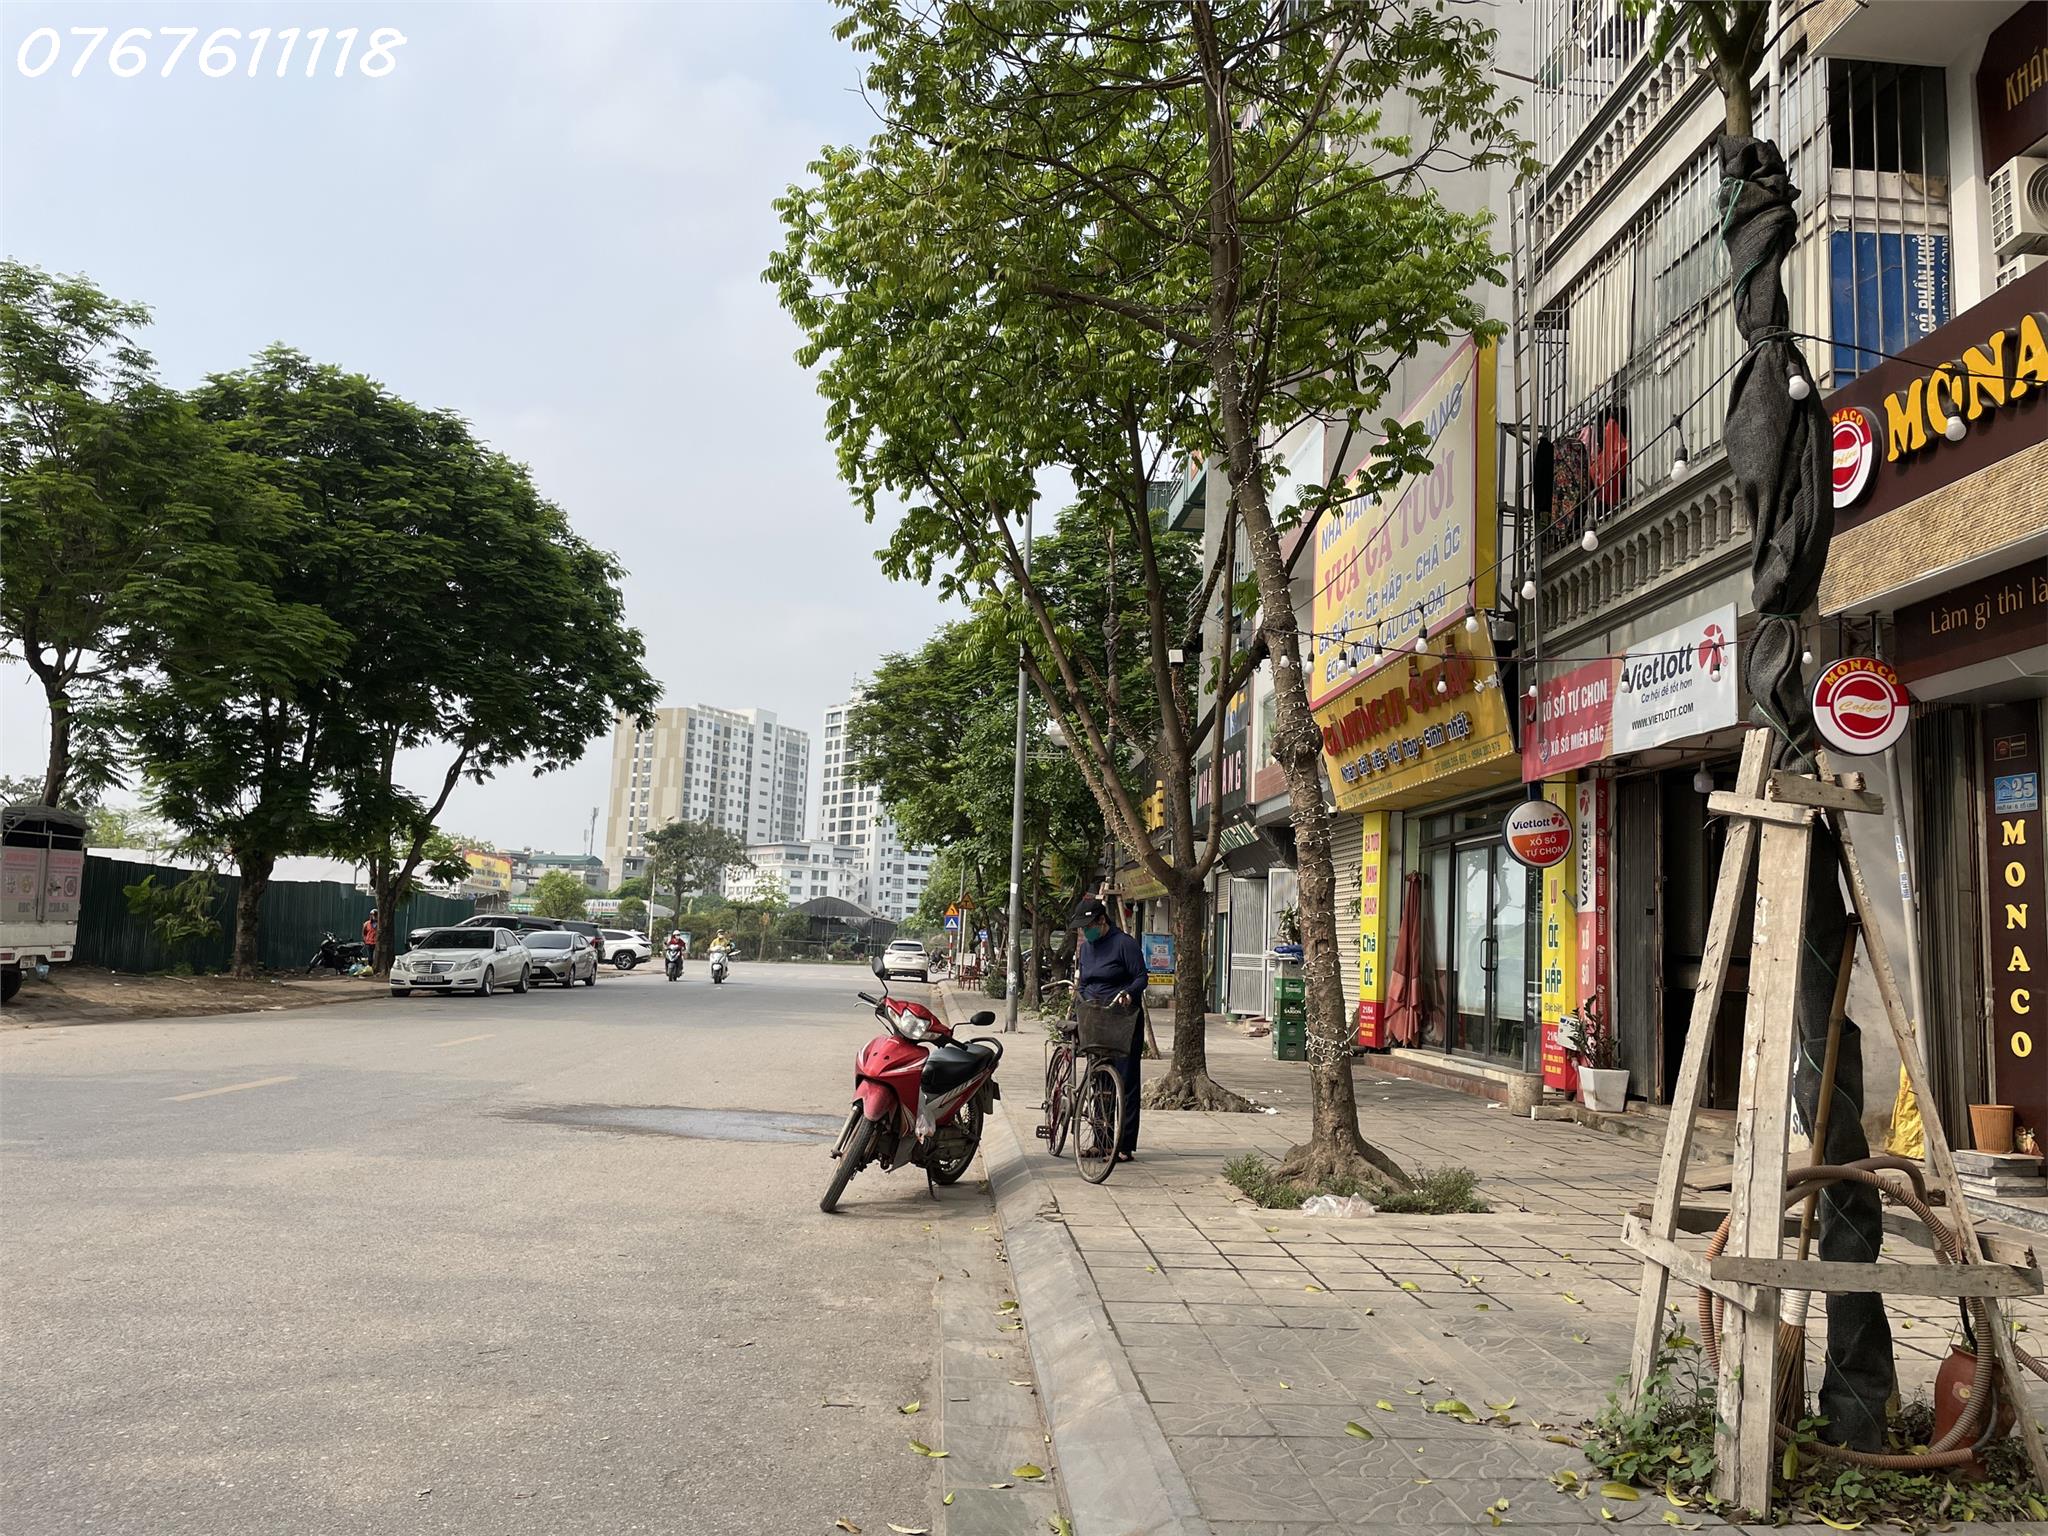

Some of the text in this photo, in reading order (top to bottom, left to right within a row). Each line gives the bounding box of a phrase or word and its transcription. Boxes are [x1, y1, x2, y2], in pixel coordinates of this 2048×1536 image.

[1832, 410, 1863, 426] NACO
[1325, 545, 1360, 611] VUA
[1365, 501, 1392, 576] GÀ
[1931, 608, 1967, 634] Làm
[1974, 595, 1991, 630] gì
[1998, 583, 2023, 615] thì
[1626, 643, 1694, 693] Vietlott
[1824, 659, 1898, 687] MONACO
[1554, 686, 1565, 718] SỐ
[1567, 686, 1580, 716] TỰ
[1582, 677, 1607, 709] CHỌN
[1838, 701, 1888, 713] Coffee
[1424, 723, 1446, 750] Sinh
[1447, 711, 1469, 742] nhật
[1632, 702, 1694, 730] WWW.VIETLOTT.COM
[1222, 748, 1241, 796] ÀNG
[2011, 776, 2034, 799] 25
[1512, 818, 1551, 830] Vietlott
[1530, 833, 1557, 846] XỔ SỐ
[1525, 845, 1564, 858] TỰ CHỌN
[1548, 913, 1559, 948] ỐC
[2001, 818, 2033, 1058] MONACO
[1545, 958, 1562, 994] HẤP
